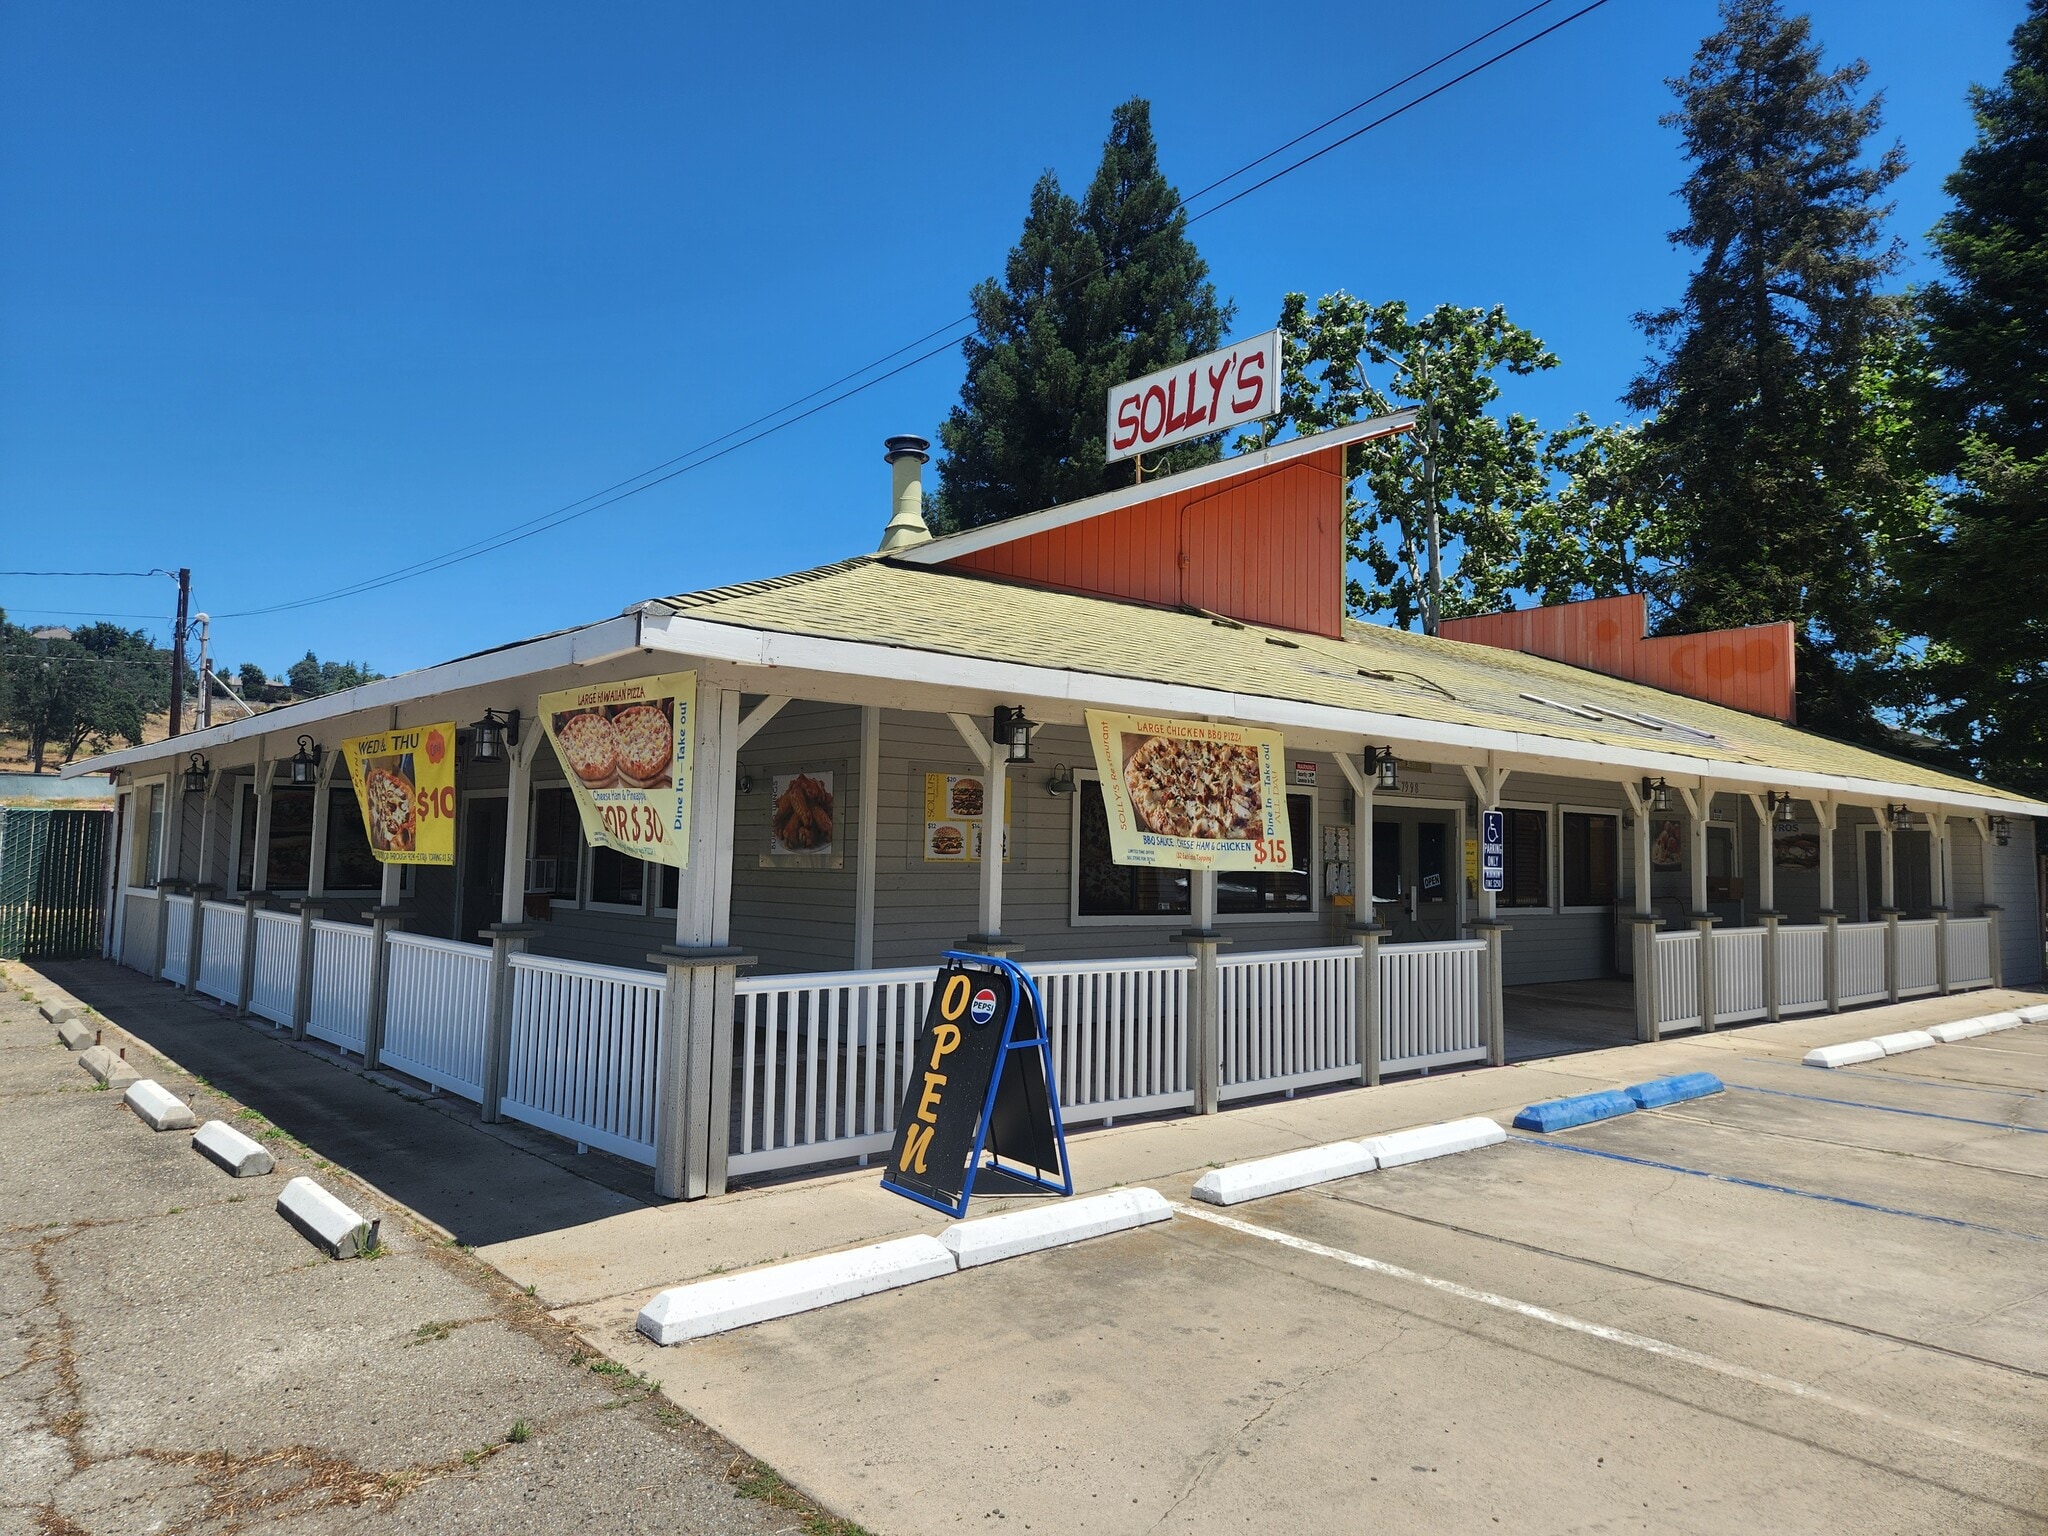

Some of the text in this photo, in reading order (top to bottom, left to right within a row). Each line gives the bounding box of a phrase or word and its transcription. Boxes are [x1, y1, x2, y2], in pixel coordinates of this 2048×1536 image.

[1113, 351, 1265, 450] SOLLY'S
[578, 692, 597, 706] LARGE
[627, 686, 645, 700] PIZZA
[678, 701, 688, 725] out
[1137, 722, 1242, 743] LARGE CHICKEN BBQ PIZZA
[359, 740, 379, 755] WED
[391, 733, 419, 751] THU
[677, 729, 686, 762] Take
[1261, 743, 1270, 761] out
[676, 778, 684, 793] In
[416, 786, 455, 822] $10
[1266, 798, 1272, 808] In
[674, 797, 683, 830] Dine
[1773, 823, 1799, 832] YROS
[1216, 842, 1251, 851] CHICKEN
[1254, 838, 1287, 865] $15
[1484, 843, 1502, 854] PARKING
[1488, 855, 1499, 866] ONLY
[1424, 875, 1440, 887] OPEN
[973, 1001, 994, 1012] PEPSI
[899, 974, 971, 1175] OPEN
